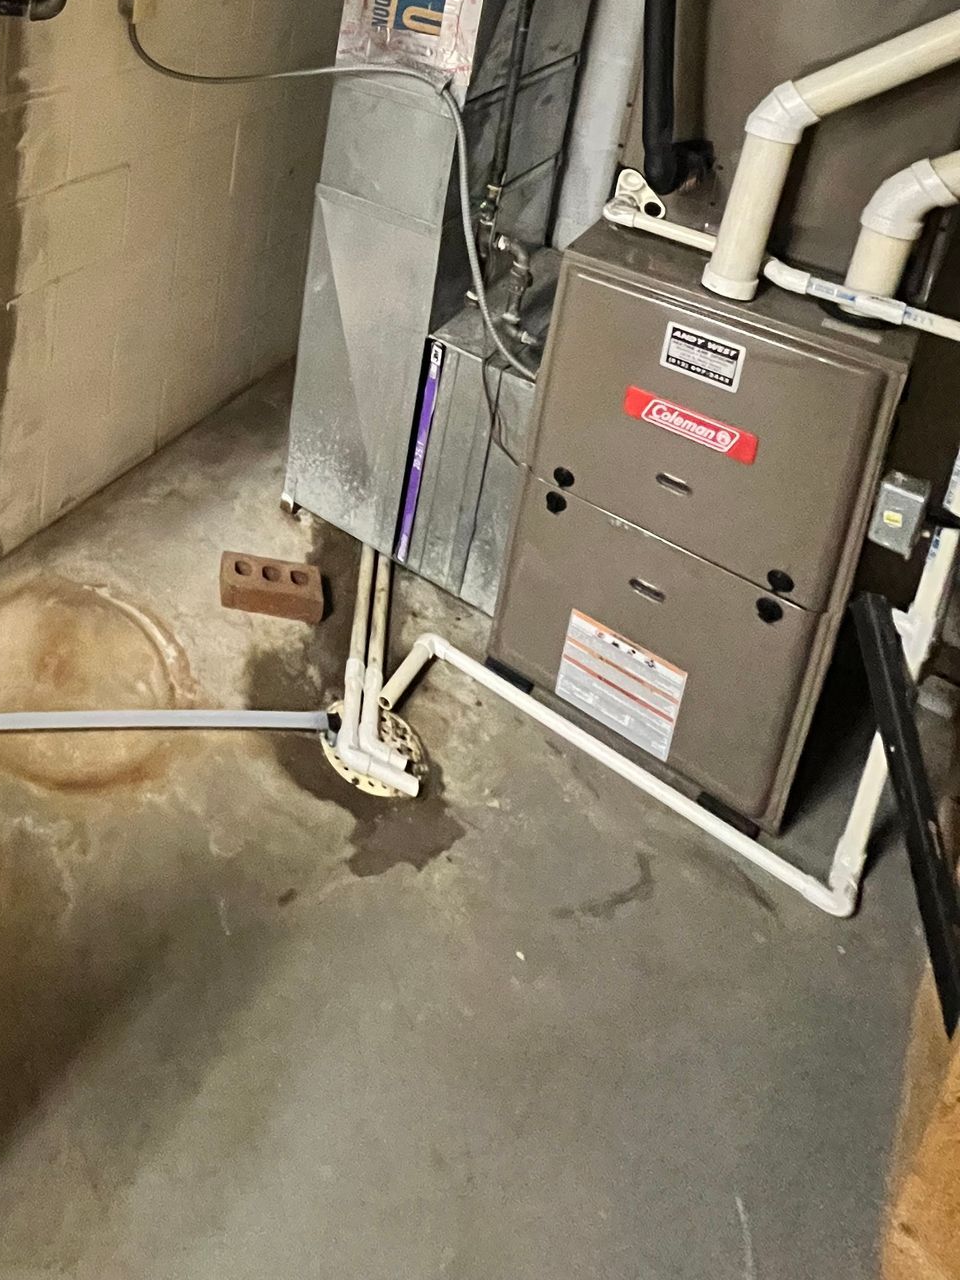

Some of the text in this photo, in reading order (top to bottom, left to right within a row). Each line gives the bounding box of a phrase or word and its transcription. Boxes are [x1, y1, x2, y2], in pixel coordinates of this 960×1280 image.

[672, 330, 706, 345] ANDY
[707, 341, 737, 357] WEST
[648, 404, 716, 440] Coleman
